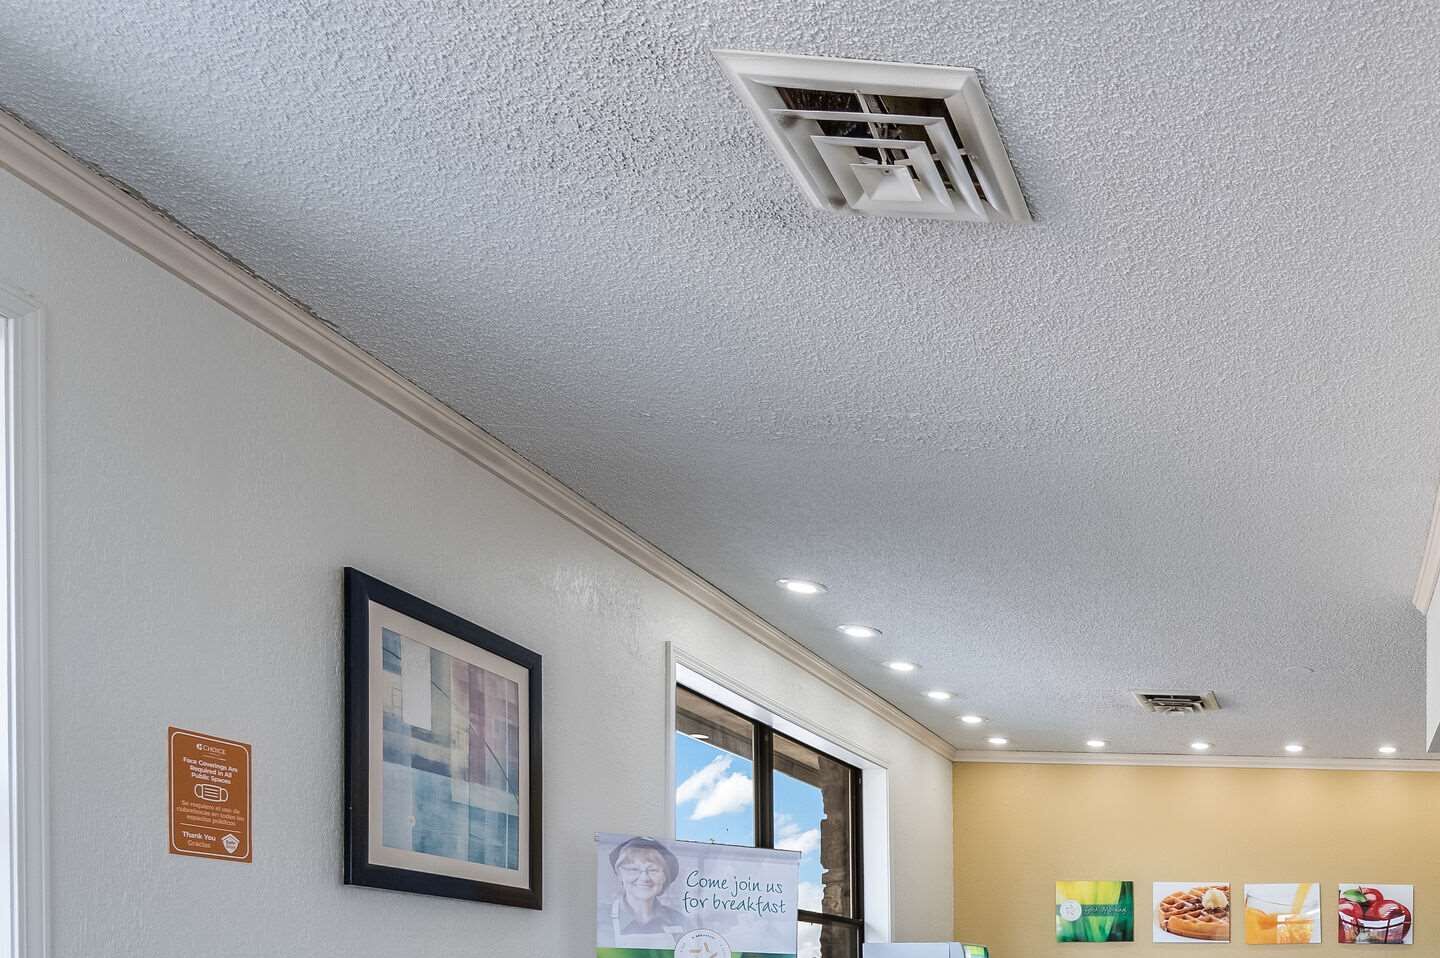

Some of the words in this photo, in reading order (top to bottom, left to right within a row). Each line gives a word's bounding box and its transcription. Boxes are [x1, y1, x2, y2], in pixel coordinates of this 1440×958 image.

[182, 831, 203, 839] Thank
[686, 870, 728, 890] Come
[731, 875, 762, 898] join
[766, 881, 783, 894] us
[682, 891, 709, 913] for
[712, 893, 786, 917] breakfast
